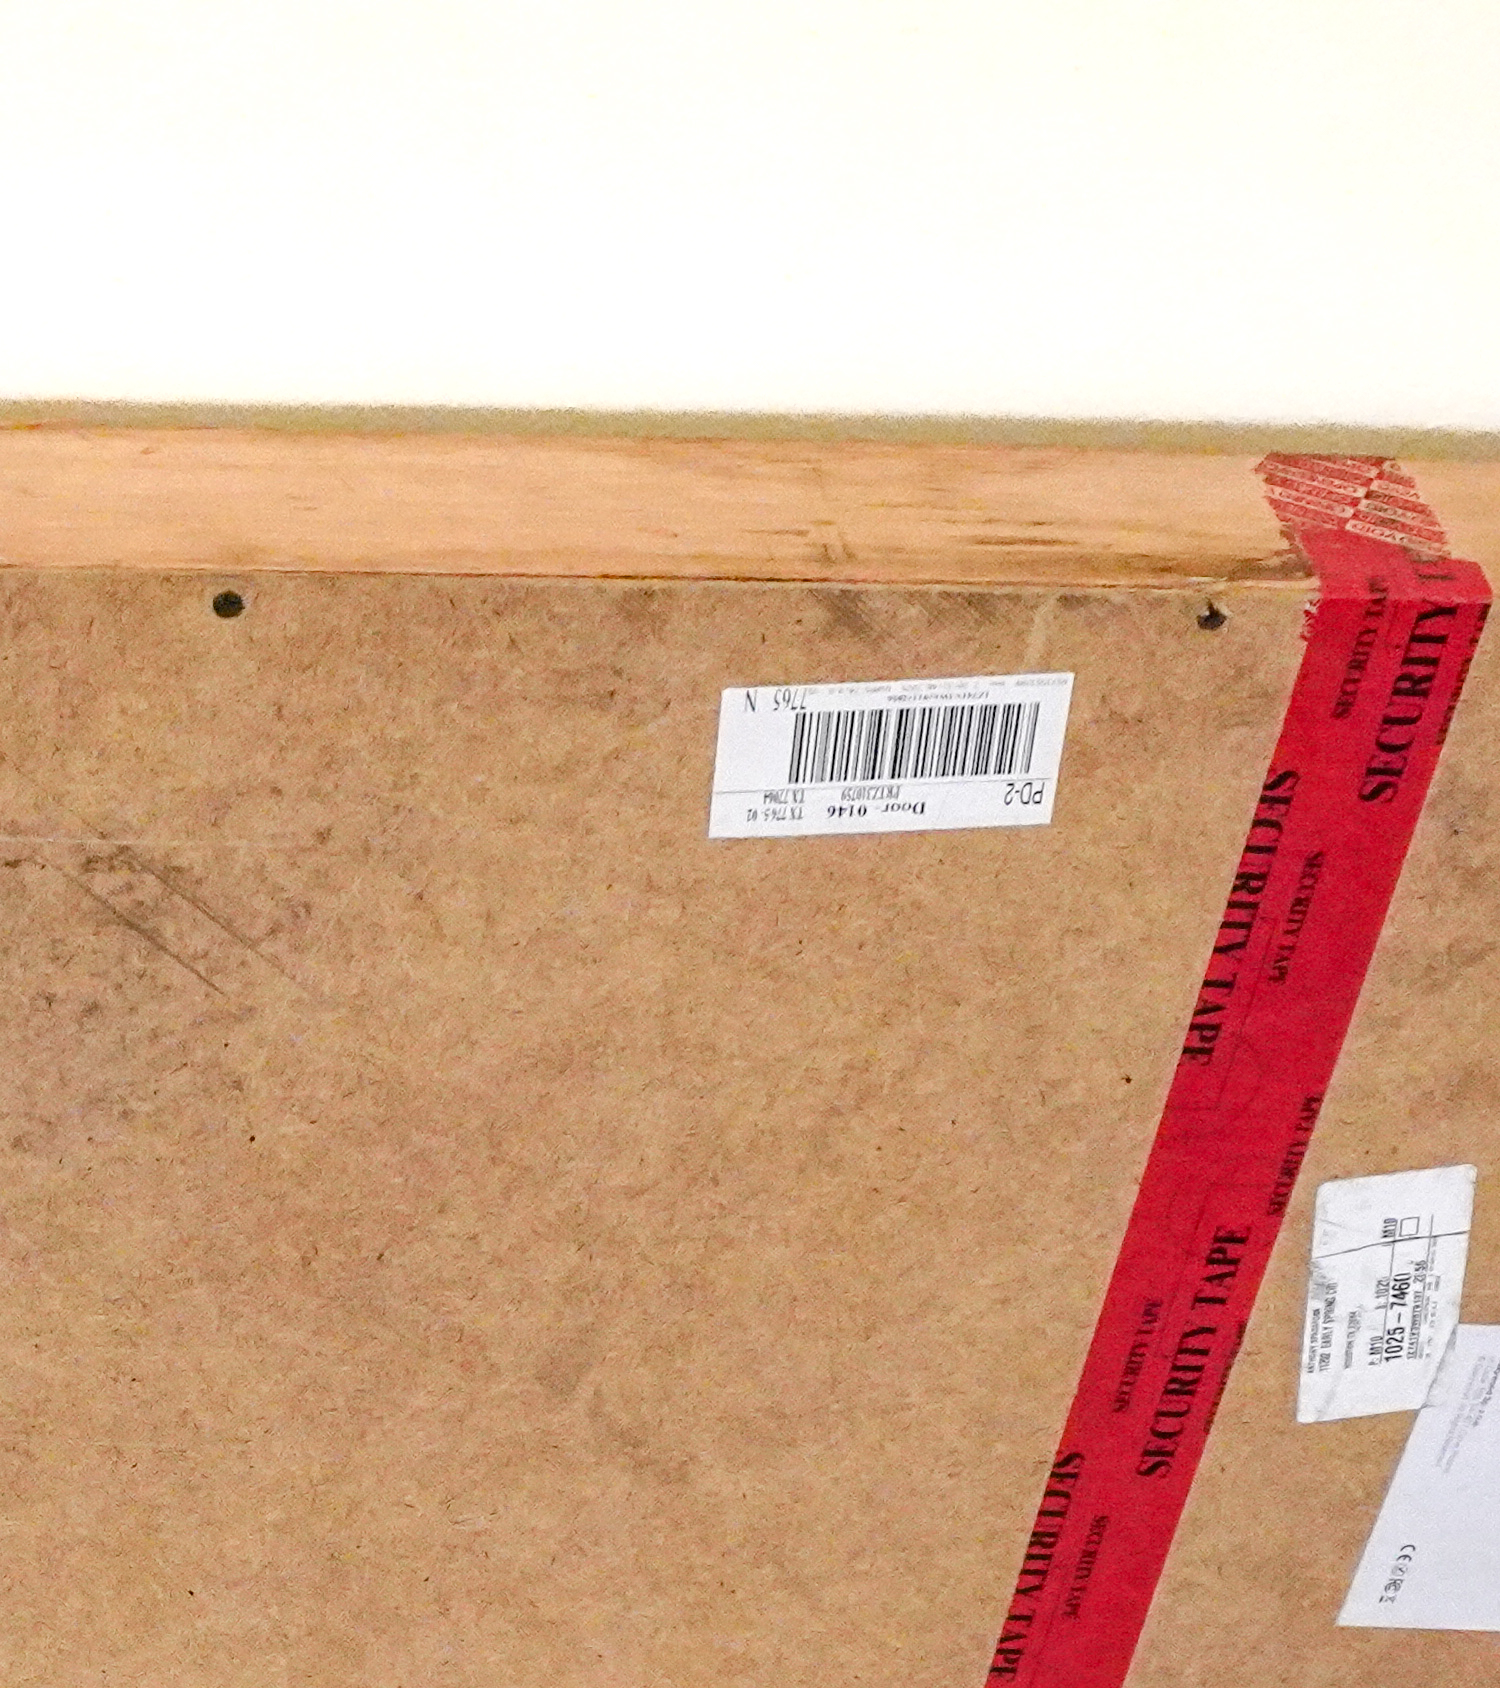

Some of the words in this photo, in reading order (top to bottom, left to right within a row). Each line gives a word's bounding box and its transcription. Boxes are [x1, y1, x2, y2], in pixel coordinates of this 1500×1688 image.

[743, 689, 757, 712] N
[772, 687, 808, 710] 7765
[1353, 598, 1460, 804] SECURITY
[826, 804, 867, 818] 0146
[1002, 781, 1044, 805] PD-2
[1209, 770, 1301, 961] SECURITY
[1178, 971, 1238, 1064] TAPE
[1382, 1217, 1397, 1238] M10
[1389, 1271, 1412, 1310] 7460
[1133, 1323, 1219, 1477] SECURITY
[1188, 1225, 1251, 1310] TAPE
[1368, 1335, 1383, 1355] M10
[1383, 1326, 1405, 1362] 1025
[1012, 1452, 1086, 1596] SECURITY
[985, 1609, 1036, 1682] TAPE
